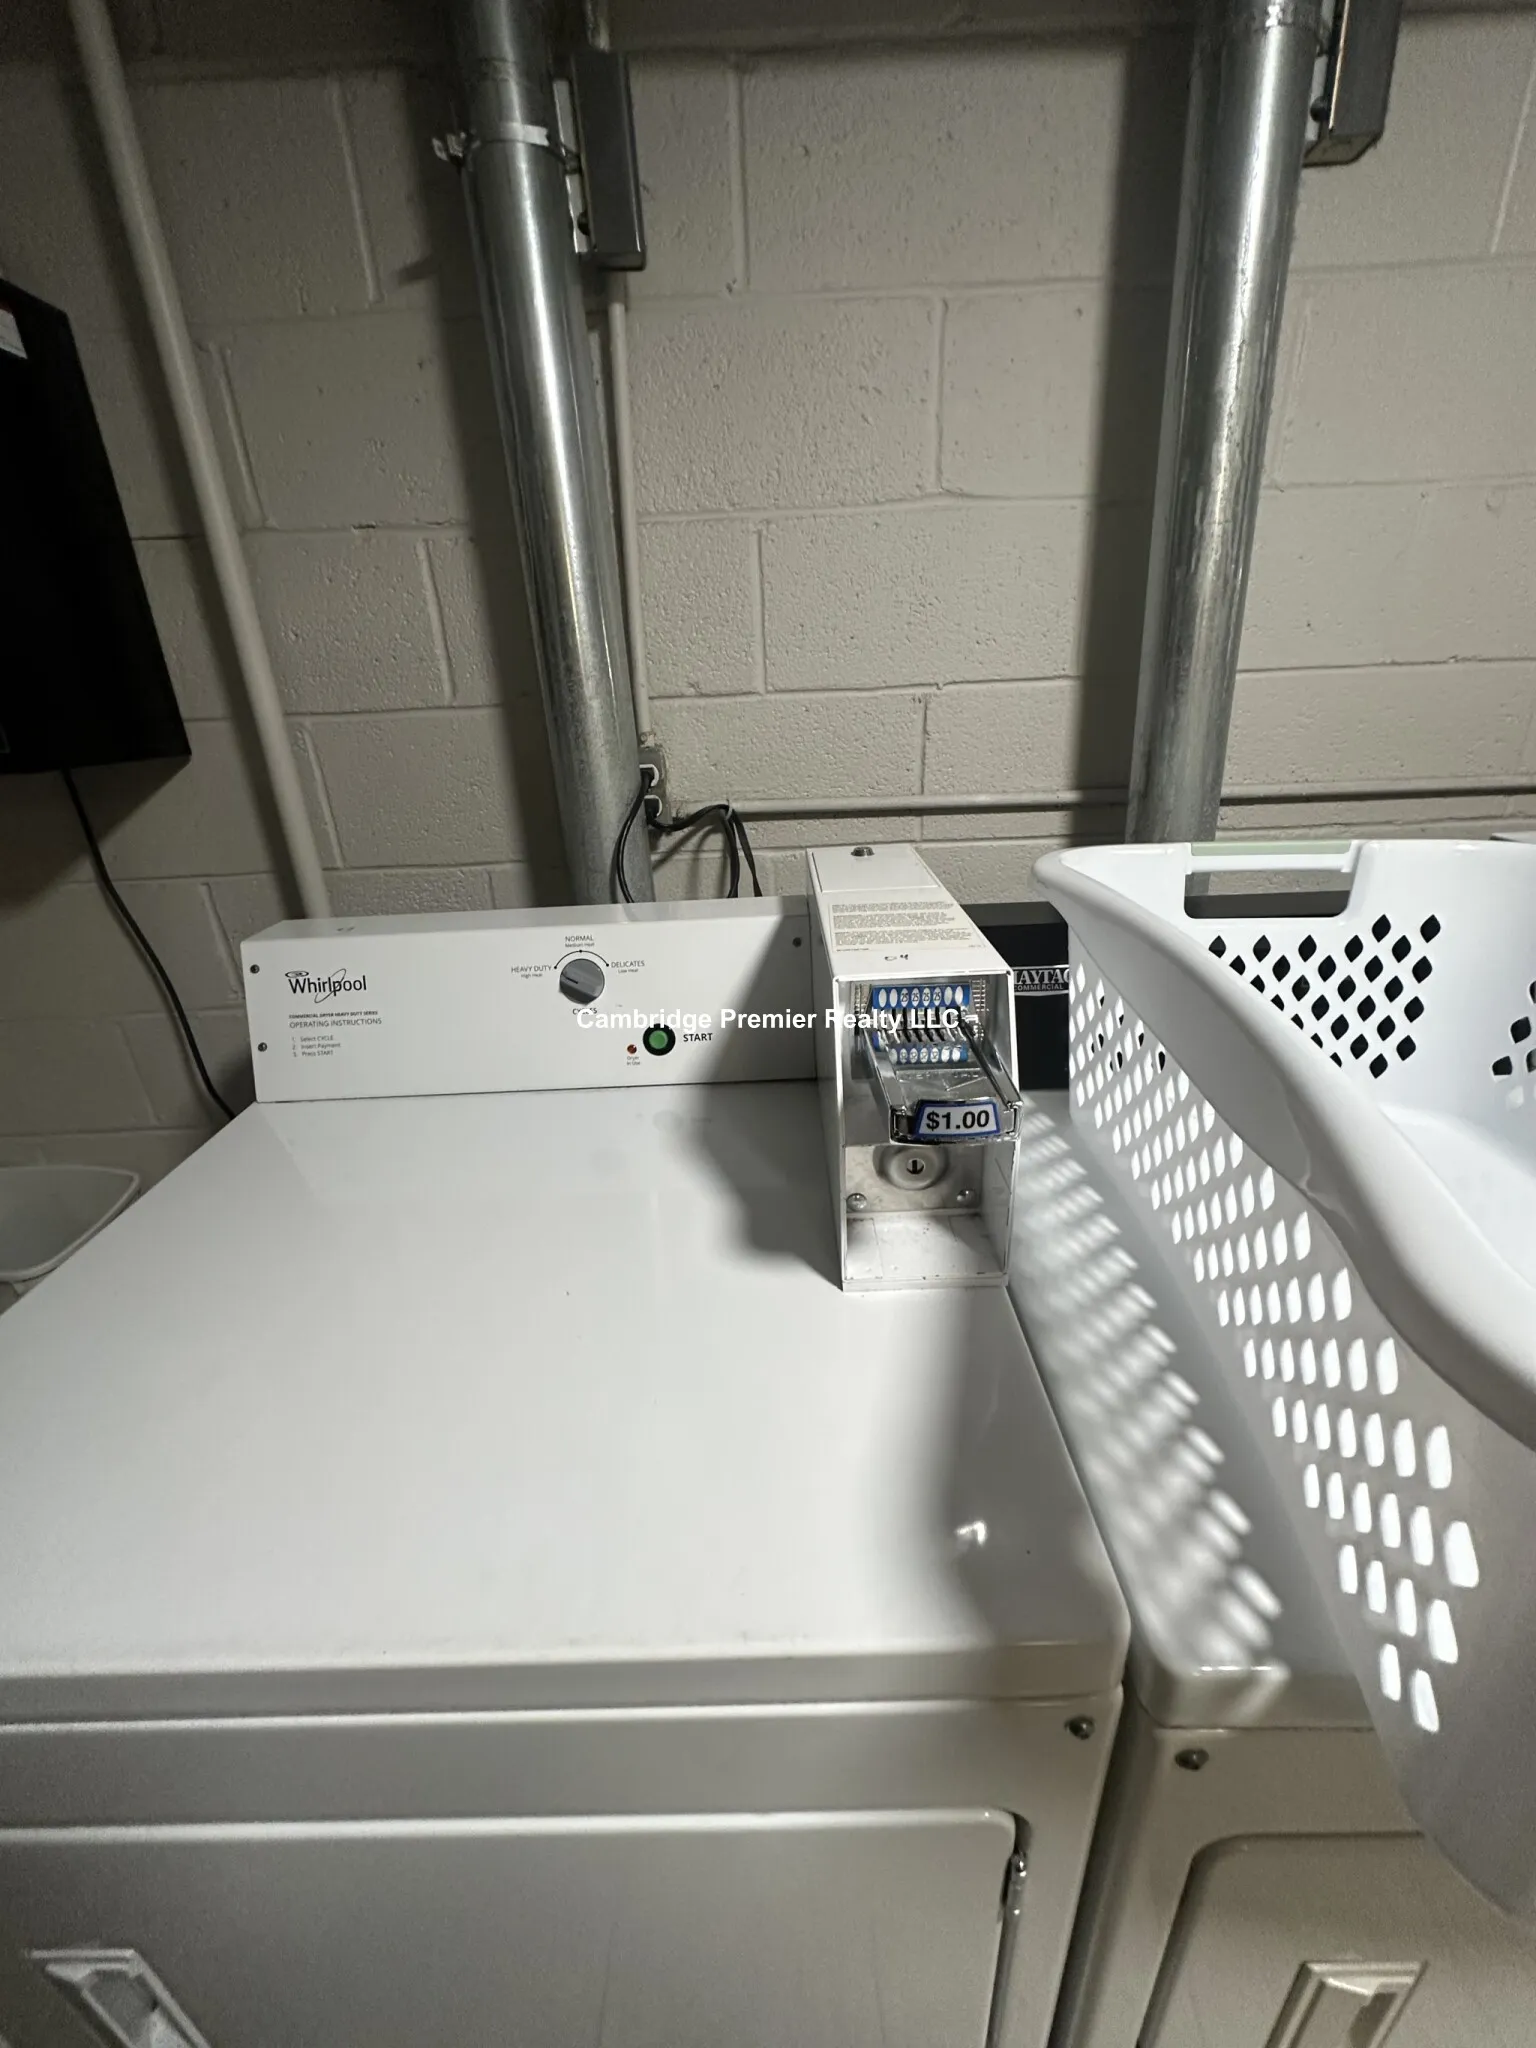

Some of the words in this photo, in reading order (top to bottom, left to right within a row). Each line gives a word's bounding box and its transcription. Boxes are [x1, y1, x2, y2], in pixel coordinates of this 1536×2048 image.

[611, 960, 645, 968] DELICATES
[288, 975, 367, 997] Whirlpool
[289, 1020, 330, 1028] OPERATING
[331, 1018, 382, 1027] INSTRUCTIONS
[683, 1033, 713, 1042] START
[926, 1110, 989, 1131] $1.00
